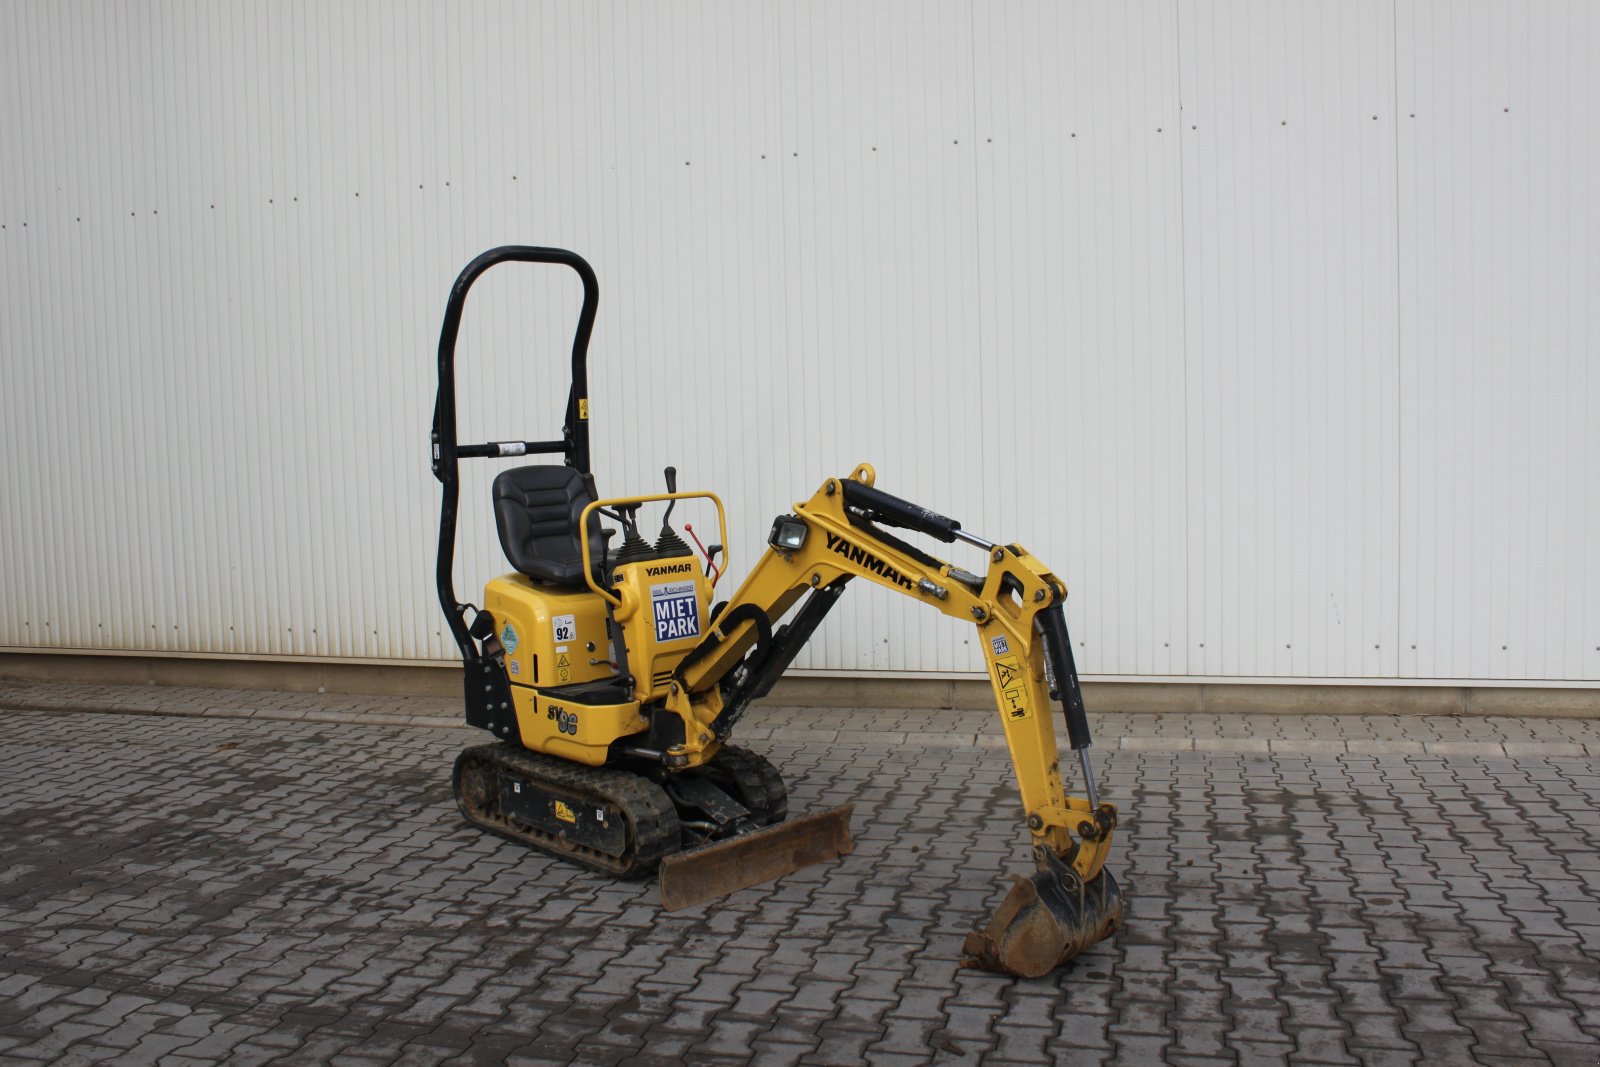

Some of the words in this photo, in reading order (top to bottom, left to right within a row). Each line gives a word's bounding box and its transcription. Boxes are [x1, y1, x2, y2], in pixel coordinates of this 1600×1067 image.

[645, 563, 692, 577] YANMAR
[655, 597, 694, 620] MIET
[556, 626, 569, 641] 92
[658, 616, 698, 639] PARK
